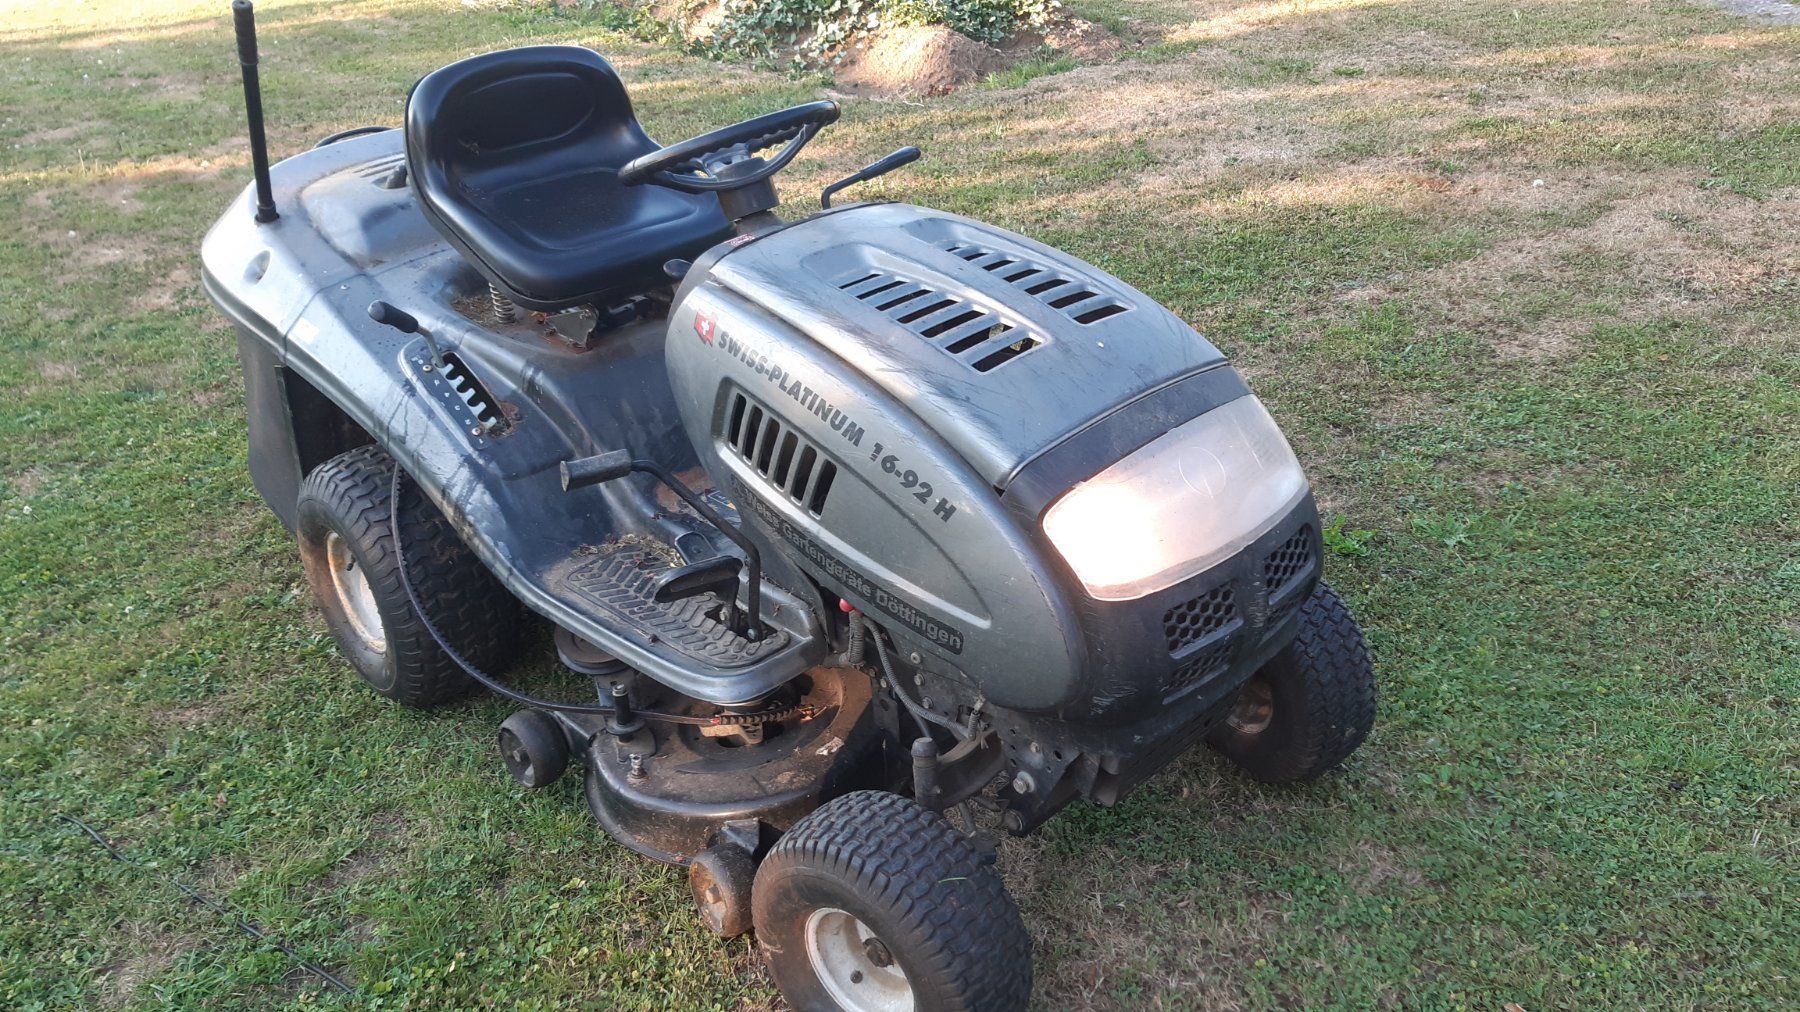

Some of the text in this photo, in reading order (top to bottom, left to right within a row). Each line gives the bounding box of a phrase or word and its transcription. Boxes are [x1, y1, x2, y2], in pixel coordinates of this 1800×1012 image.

[718, 331, 957, 523] SWISS-PLATINUM 16-92 H
[783, 523, 872, 597] Gartengeräte
[876, 589, 962, 650] Döttingen
